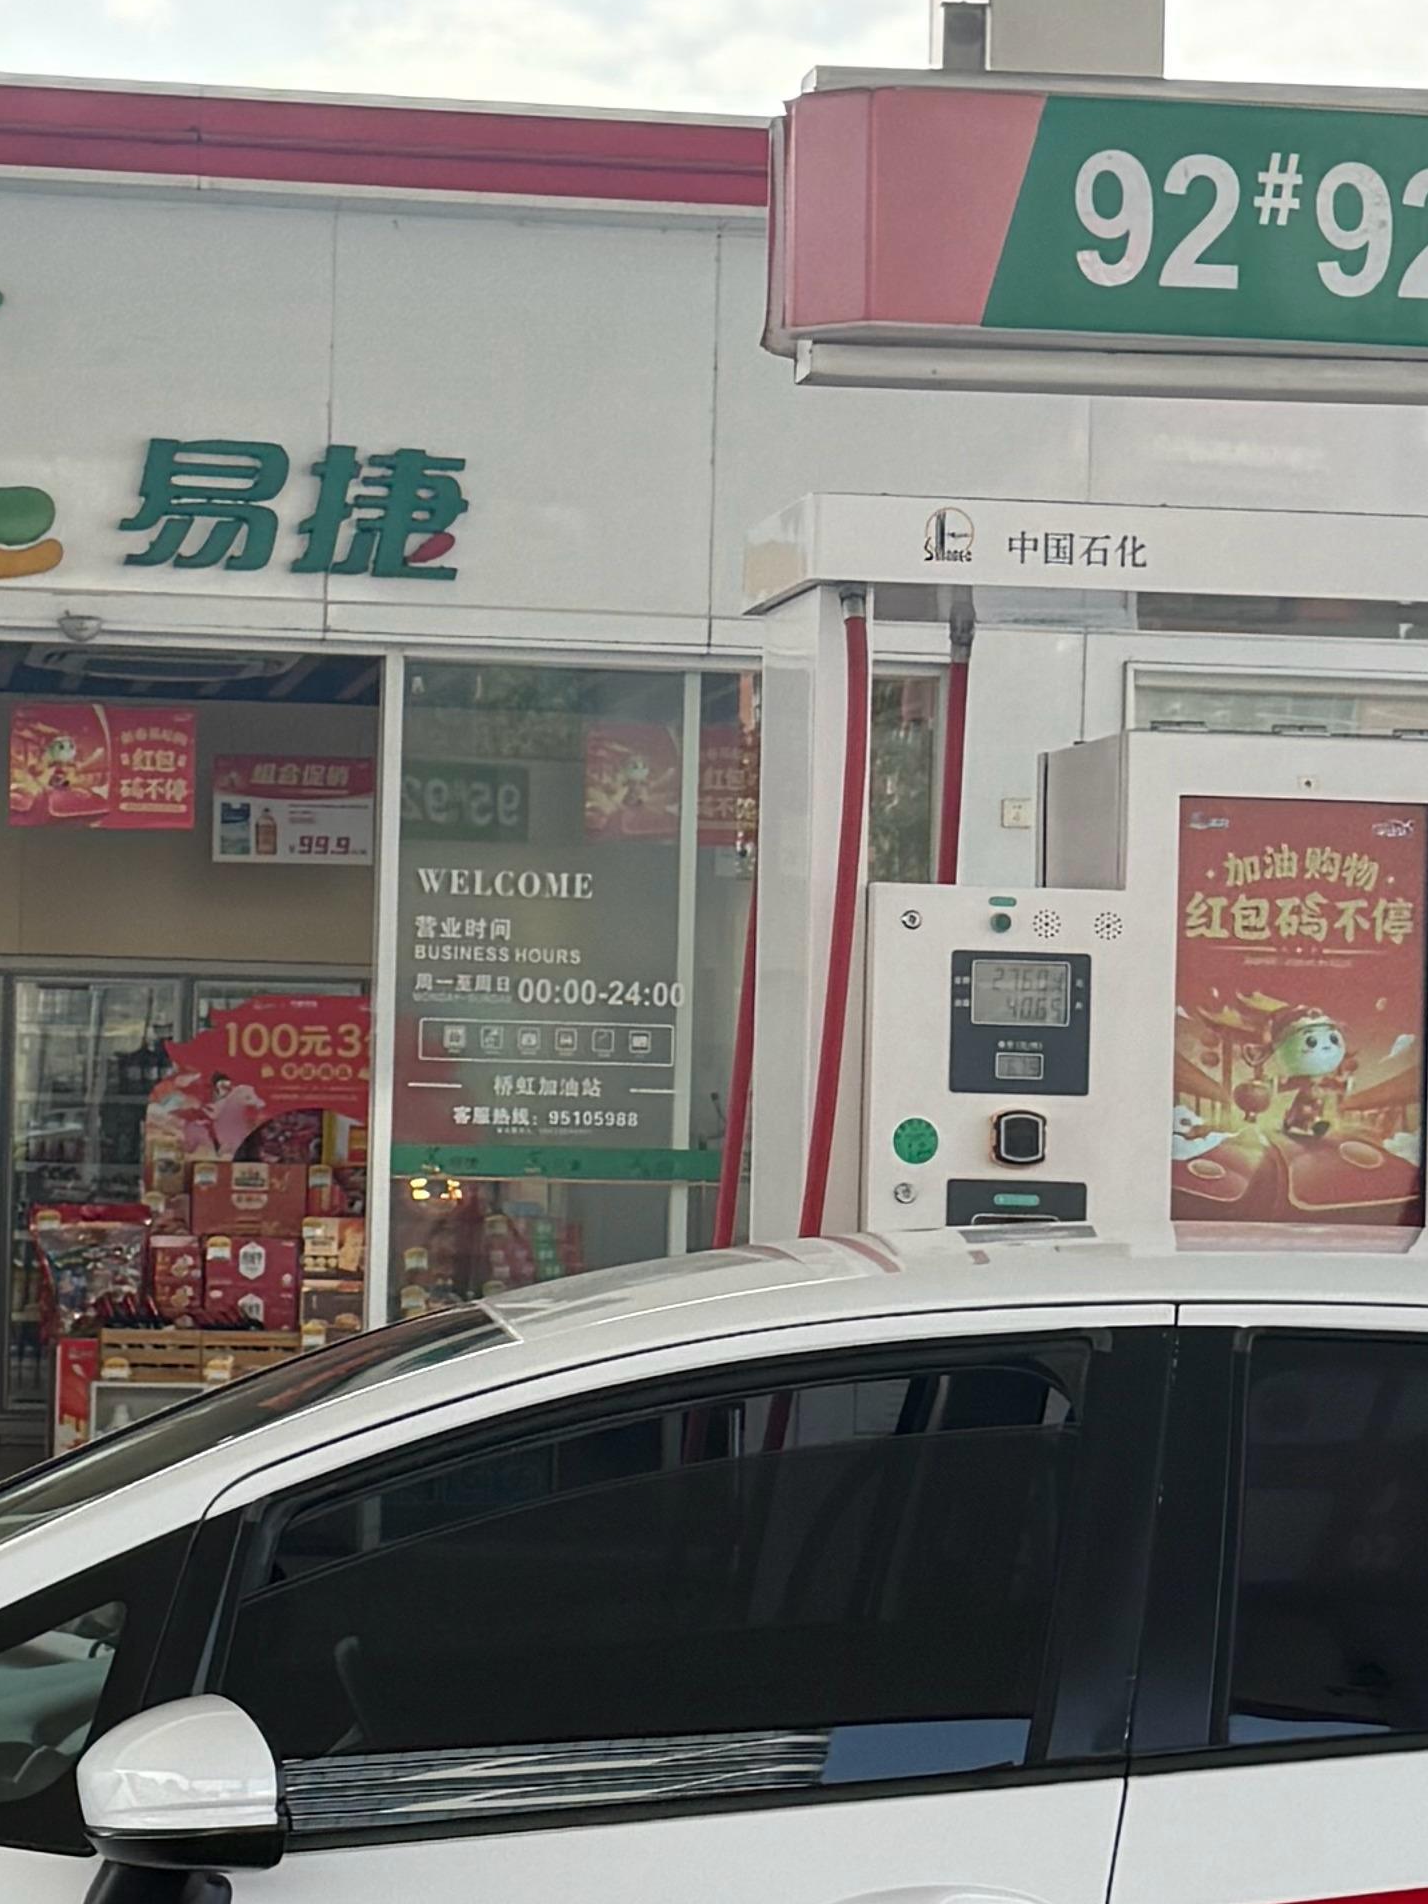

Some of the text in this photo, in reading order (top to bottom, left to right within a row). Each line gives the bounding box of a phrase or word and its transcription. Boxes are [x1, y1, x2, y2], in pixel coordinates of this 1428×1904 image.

[119, 437, 469, 581] 易捷
[1008, 530, 1148, 568] 中国石化
[418, 868, 593, 899] WELCOME
[1224, 843, 1379, 892] 加油购物
[414, 915, 512, 940] 营业时间
[414, 944, 581, 965] BUSINESS HOURS
[414, 973, 511, 992] 周一至周日
[518, 977, 686, 1007] 00:00-24:00
[225, 1021, 372, 1059] 100元3
[548, 1110, 639, 1128] 95105988
